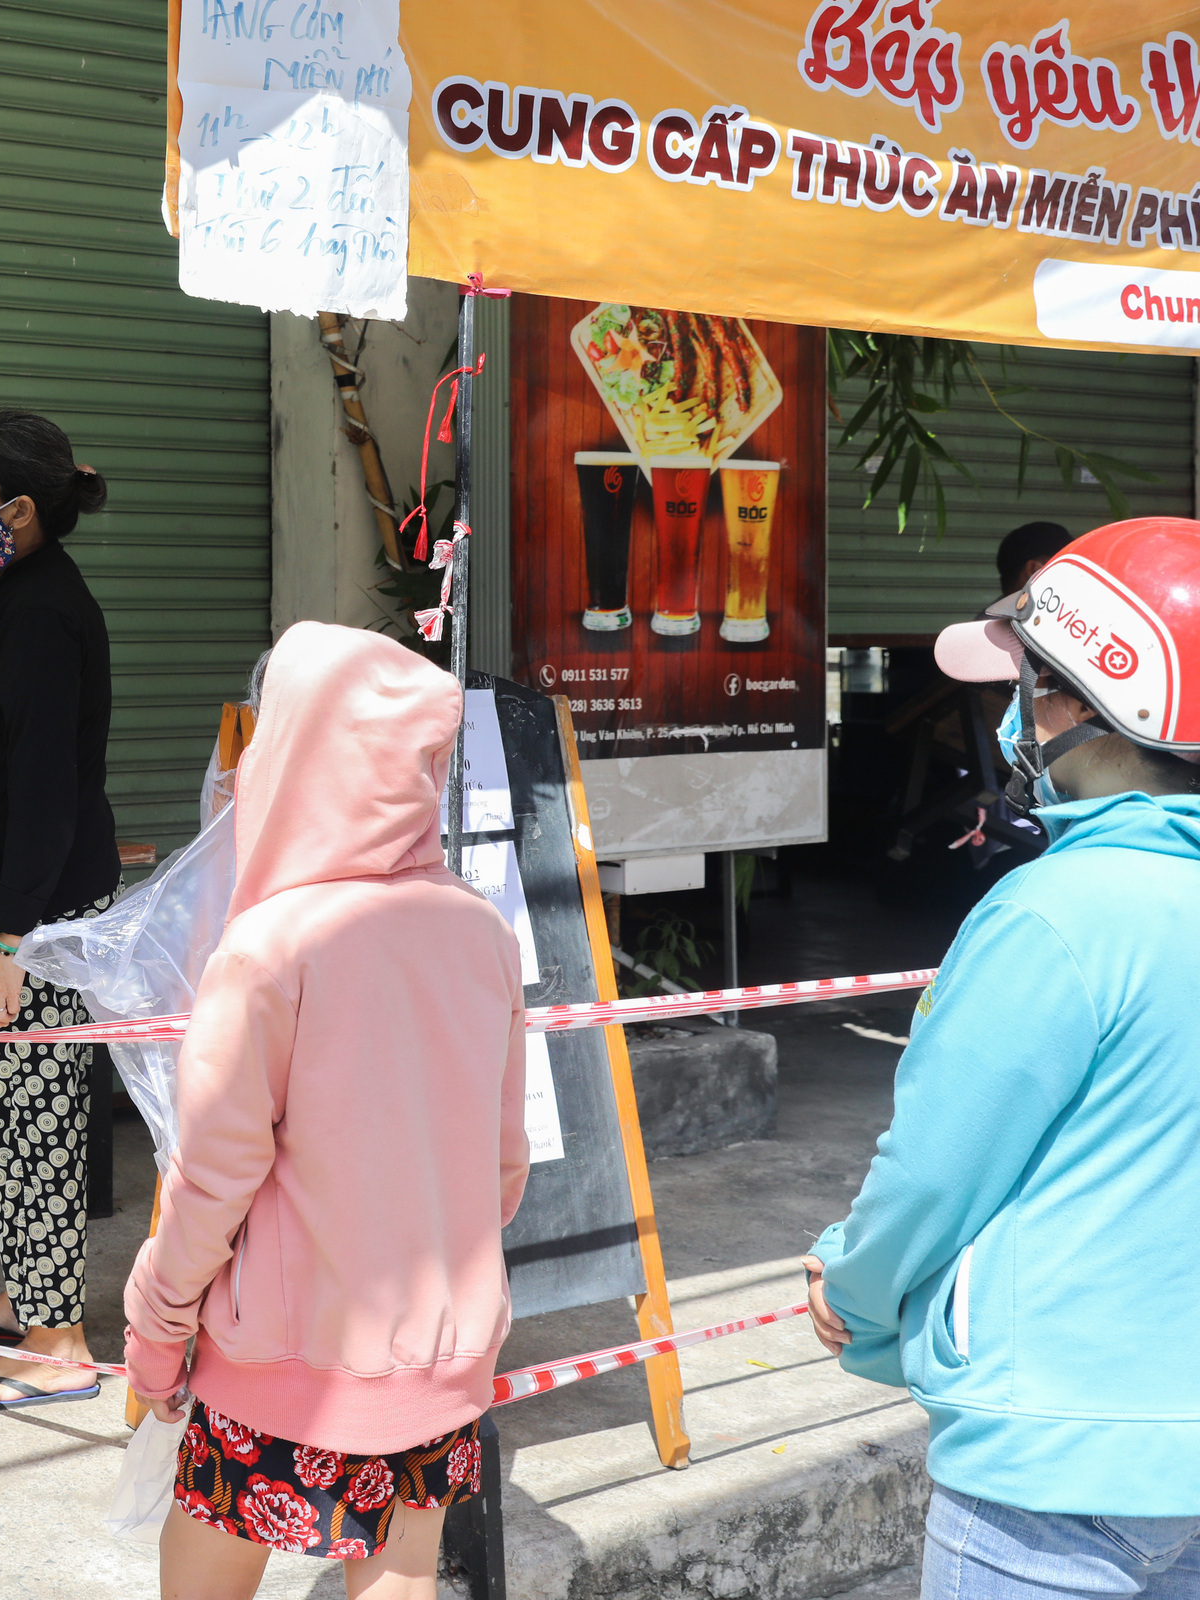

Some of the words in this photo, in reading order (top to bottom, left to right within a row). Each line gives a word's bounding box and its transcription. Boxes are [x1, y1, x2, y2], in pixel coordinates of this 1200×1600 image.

[987, 28, 1134, 143] yêu
[437, 83, 635, 166] CUNG
[652, 111, 776, 184] CẤP
[792, 139, 937, 210] THỨC
[944, 153, 1017, 222] ĂN
[1022, 172, 1128, 239] MIỄN
[289, 175, 314, 210] 2
[260, 219, 285, 253] 6
[1121, 284, 1200, 323] Chun
[561, 669, 586, 681] 0911
[589, 669, 607, 681] 531
[610, 668, 629, 680] 577
[568, 699, 587, 713] 28)
[590, 698, 615, 712] 3636
[617, 697, 642, 710] 3613
[580, 731, 597, 743] Ung
[774, 722, 795, 733] Minh
[477, 781, 483, 791] 6
